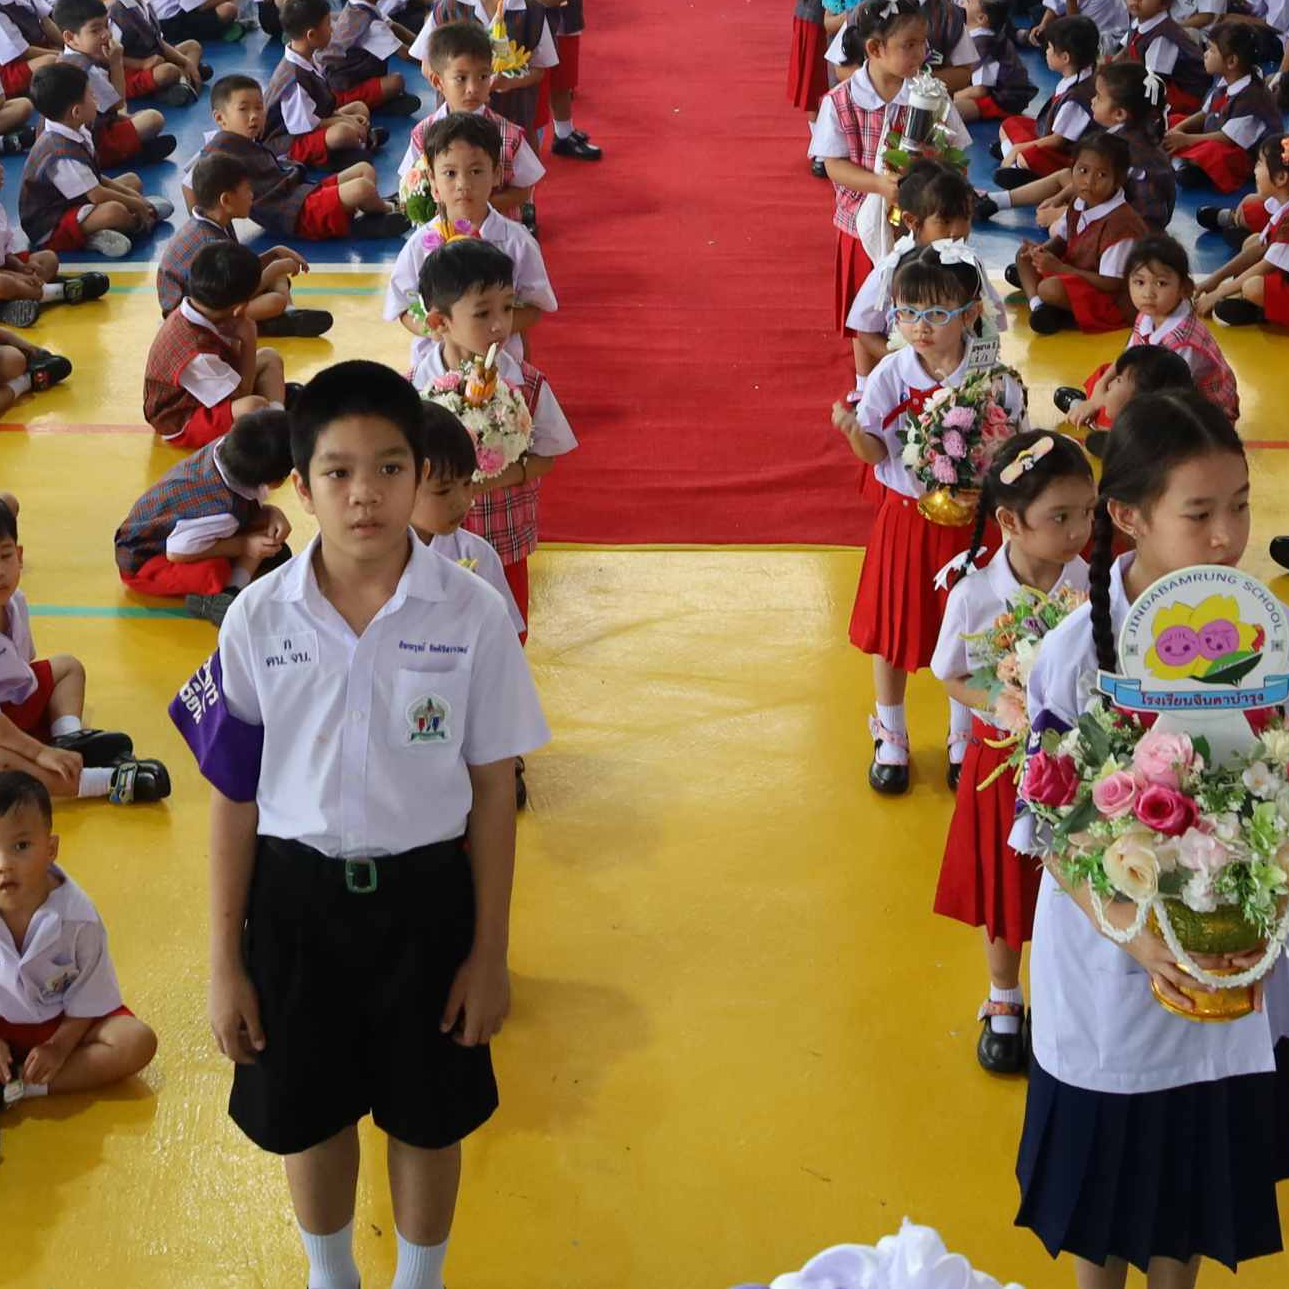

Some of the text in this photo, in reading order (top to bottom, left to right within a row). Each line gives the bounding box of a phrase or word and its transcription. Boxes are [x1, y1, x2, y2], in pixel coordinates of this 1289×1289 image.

[1127, 571, 1285, 637] JINDABAMRUNG SCHOOL
[283, 638, 292, 651] ก
[1140, 690, 1265, 707] โรงเรียนจินดาบำรุง
